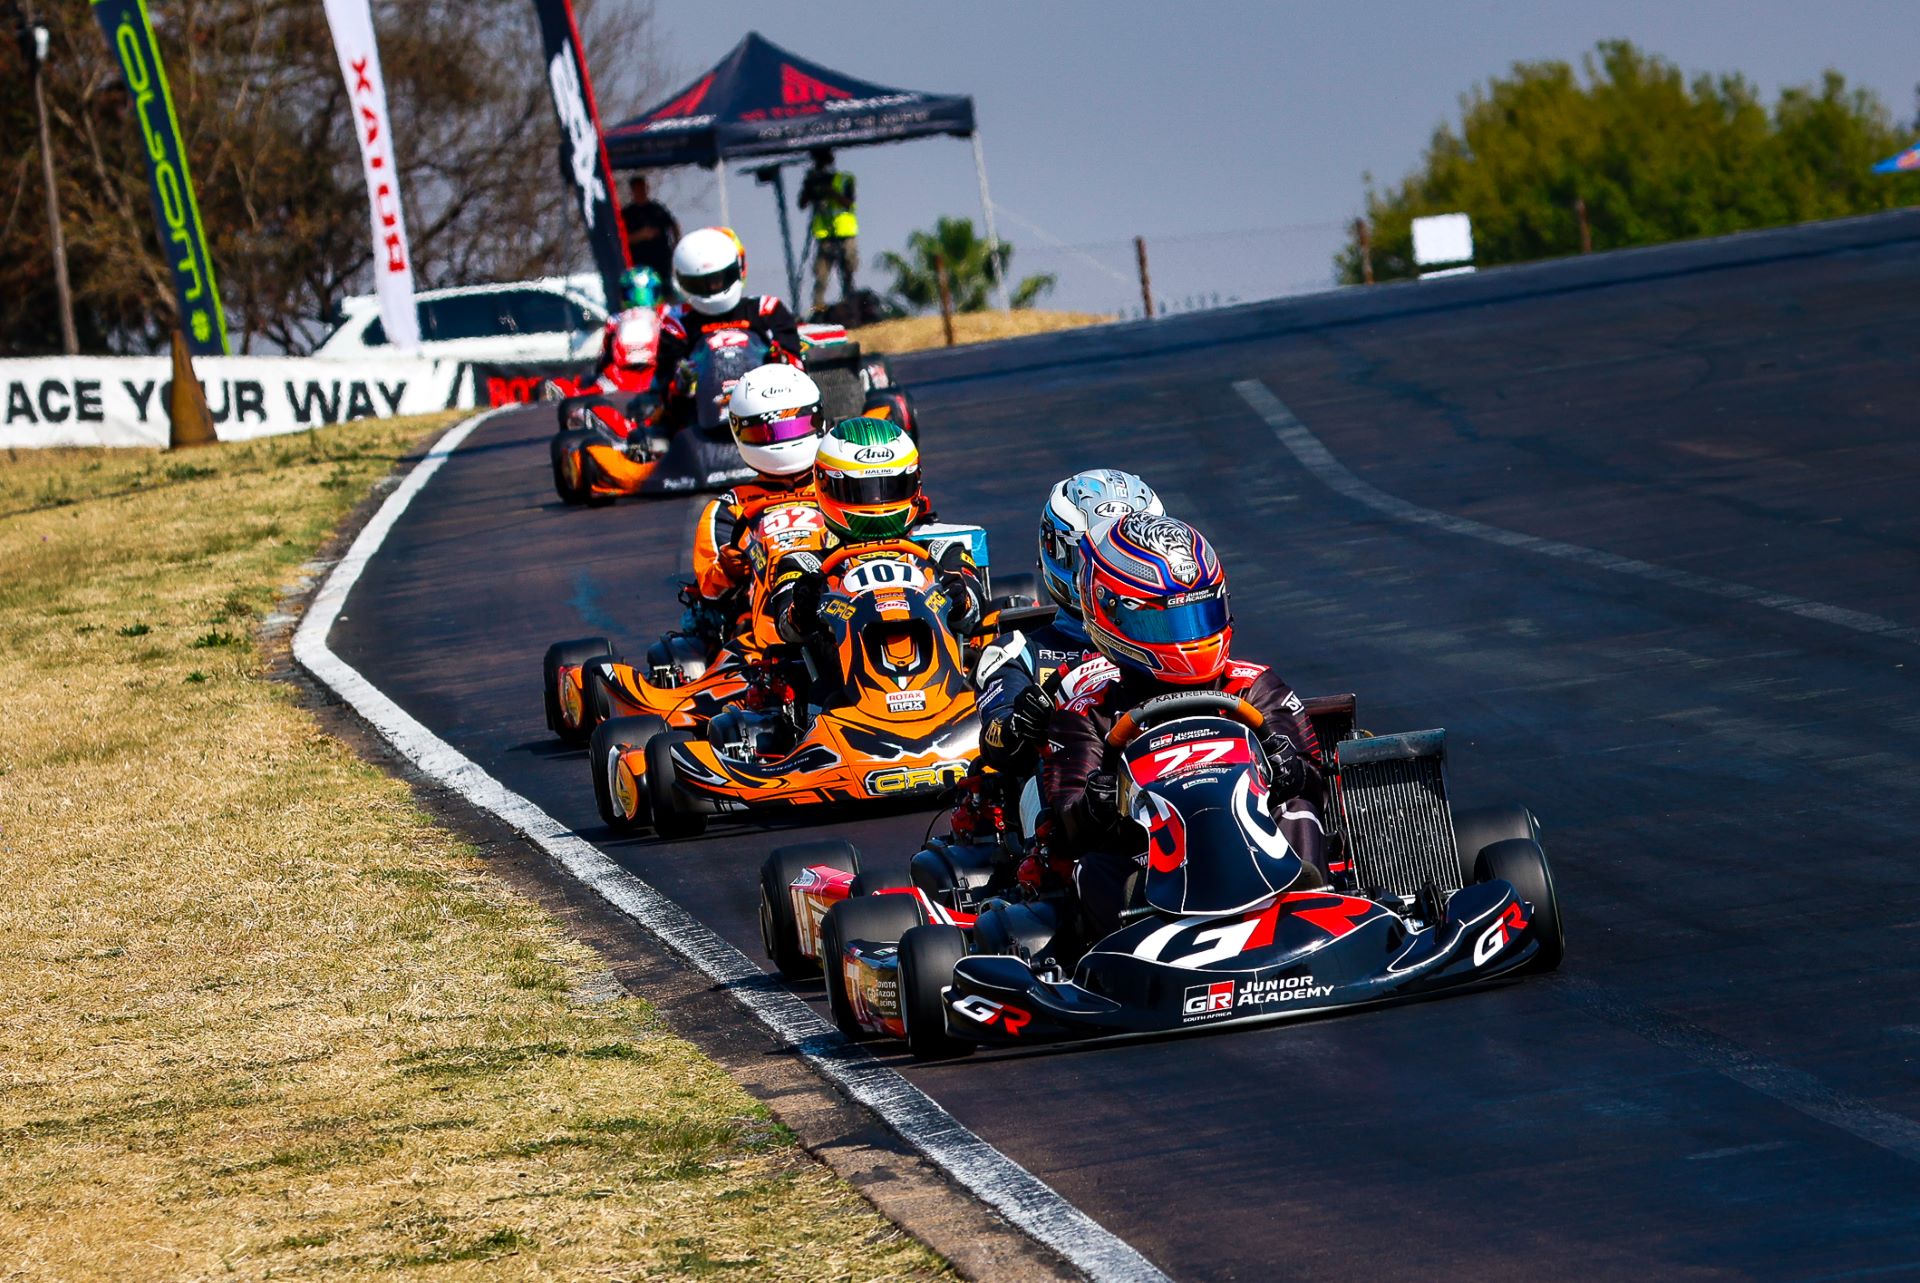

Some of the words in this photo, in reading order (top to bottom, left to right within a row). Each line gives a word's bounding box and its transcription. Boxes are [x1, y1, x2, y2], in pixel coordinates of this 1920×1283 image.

[285, 380, 408, 424] WAY
[863, 448, 890, 459] Arai
[763, 507, 818, 534] 52
[851, 563, 912, 587] 107
[825, 600, 856, 621] CRG
[1039, 649, 1080, 660] RDS
[889, 693, 922, 702] ROTAX
[1154, 741, 1234, 776] 77
[1133, 891, 1372, 968] GR
[1473, 901, 1528, 967] GR
[1240, 975, 1314, 994] JUNIOR
[1185, 992, 1231, 1013] GR
[1237, 985, 1335, 1007] ACADEMY
[952, 995, 1032, 1037] GR
[1183, 1014, 1206, 1022] SOUTH
[1207, 1011, 1232, 1019] AFRICA
